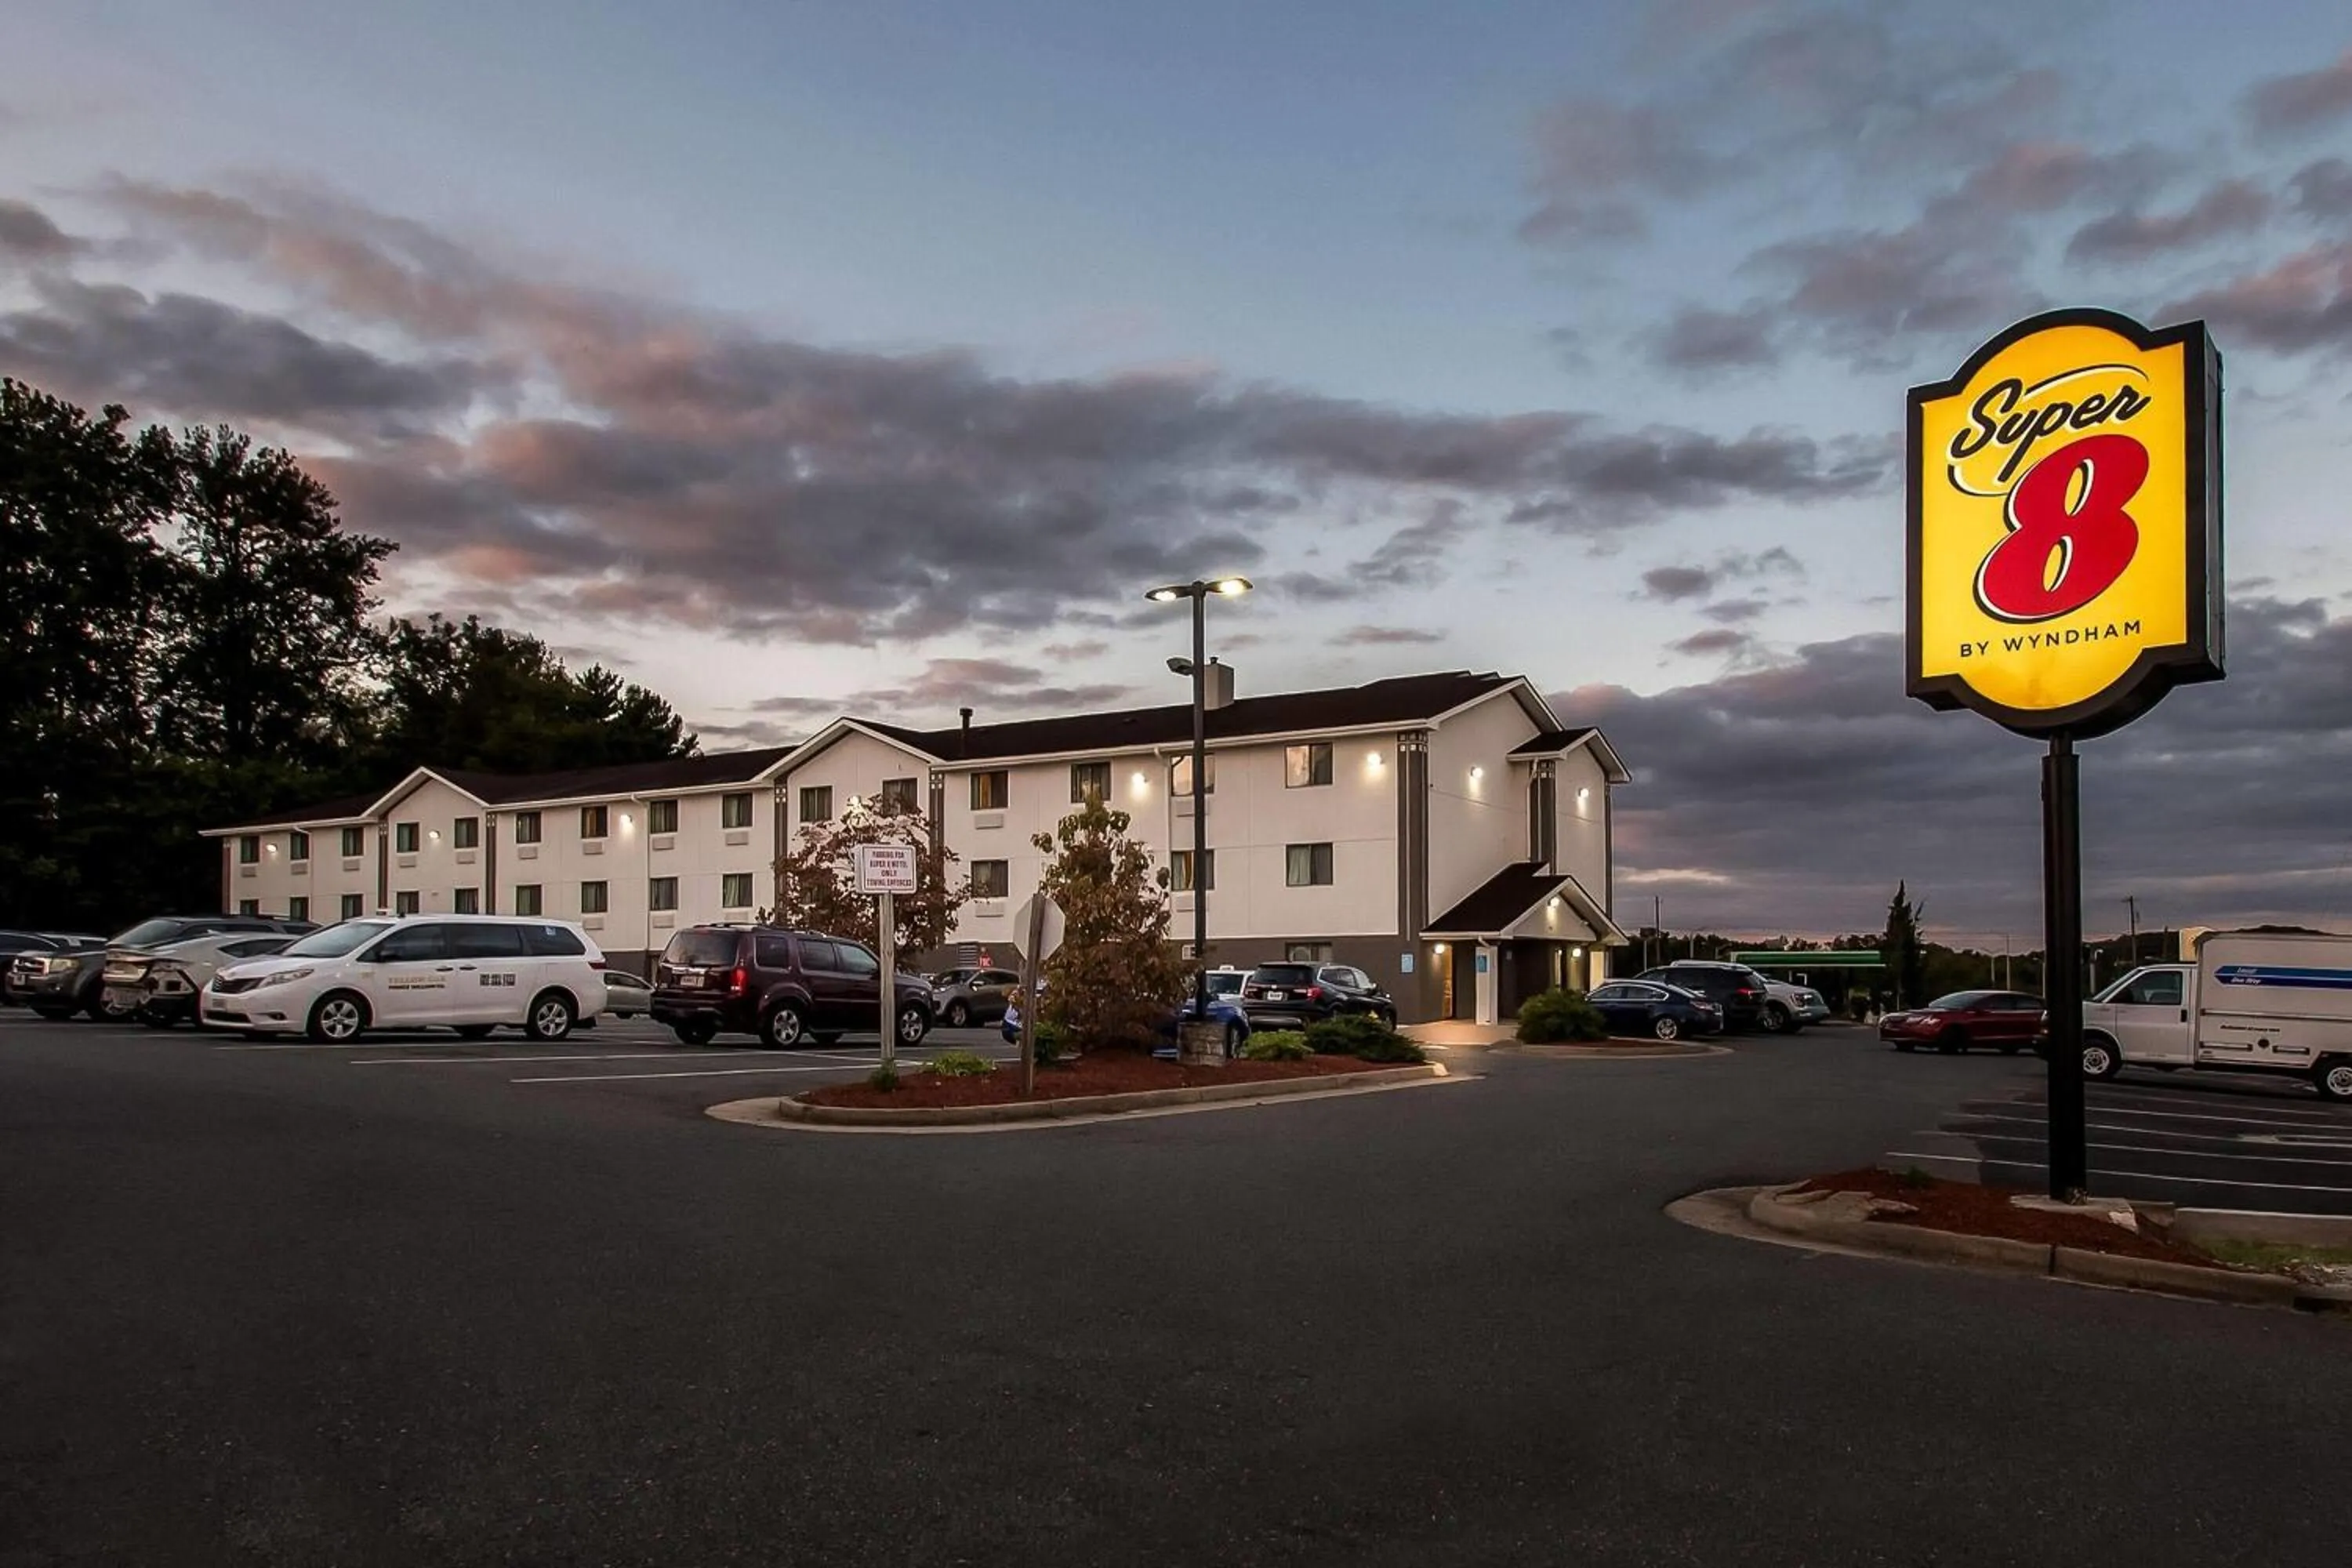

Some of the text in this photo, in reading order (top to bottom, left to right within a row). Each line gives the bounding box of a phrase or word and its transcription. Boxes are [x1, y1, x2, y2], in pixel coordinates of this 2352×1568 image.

[1951, 378, 2151, 482] Super
[1972, 434, 2150, 625] 8
[1960, 620, 2140, 658] BY WYNDHAM
